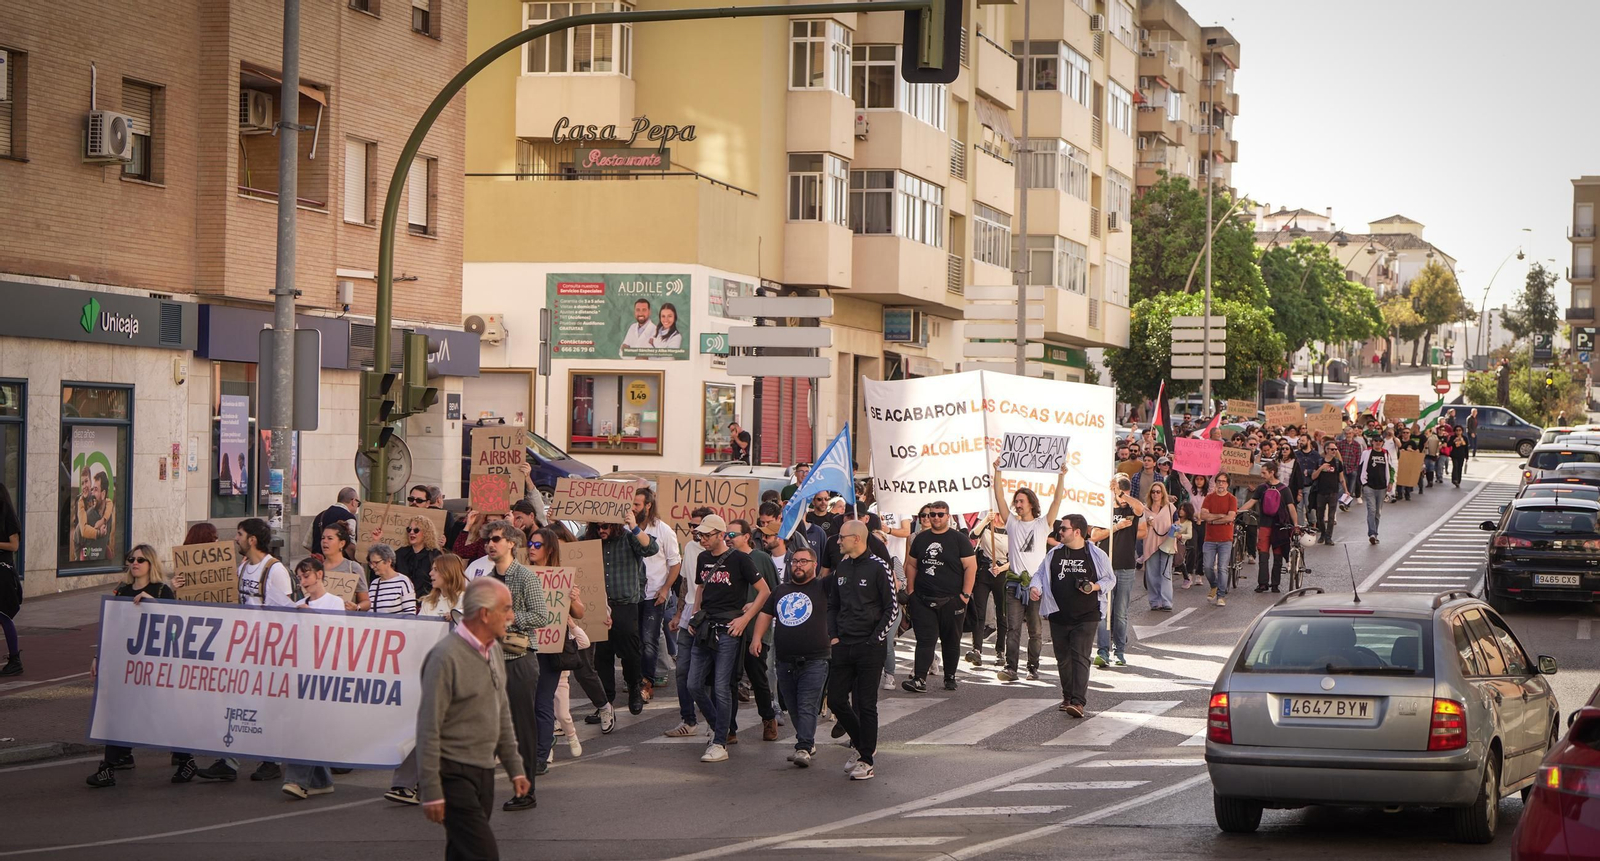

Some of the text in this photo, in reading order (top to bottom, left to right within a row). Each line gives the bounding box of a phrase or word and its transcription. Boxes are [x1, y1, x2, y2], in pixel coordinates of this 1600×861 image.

[552, 115, 697, 153] Casa Pepa
[582, 149, 662, 168] Restaurante
[618, 281, 663, 294] AUDILE
[101, 312, 139, 338] Unicaja
[1535, 335, 1543, 346] P
[1578, 334, 1588, 347] P
[630, 391, 646, 400] 1.49
[870, 399, 1104, 428] SE ACABARON LAS CASAS VACÍAS
[488, 436, 511, 449] TU
[1004, 435, 1070, 454] NOS DEJAN
[479, 450, 521, 466] AIRBNB
[890, 445, 917, 459] LOS
[1000, 452, 1020, 468] SIN
[1020, 453, 1063, 470] CASAS
[1223, 450, 1247, 458] CASEROS
[675, 478, 749, 507] MENOS
[878, 478, 891, 492] LA
[892, 480, 916, 493] PAZ
[919, 479, 958, 494] PARA
[962, 474, 991, 491] LOS
[175, 547, 232, 568] NI CASAS
[179, 567, 233, 588] SIN GENTE
[126, 613, 406, 675] JEREZ PARA VIVIR
[124, 660, 402, 706] POR EL DERECHO A LA VIVIENDA
[224, 707, 257, 722] JEREZ
[1292, 700, 1332, 714] 4647
[1337, 701, 1368, 716] BYW
[231, 725, 262, 734] VIVIENDA
